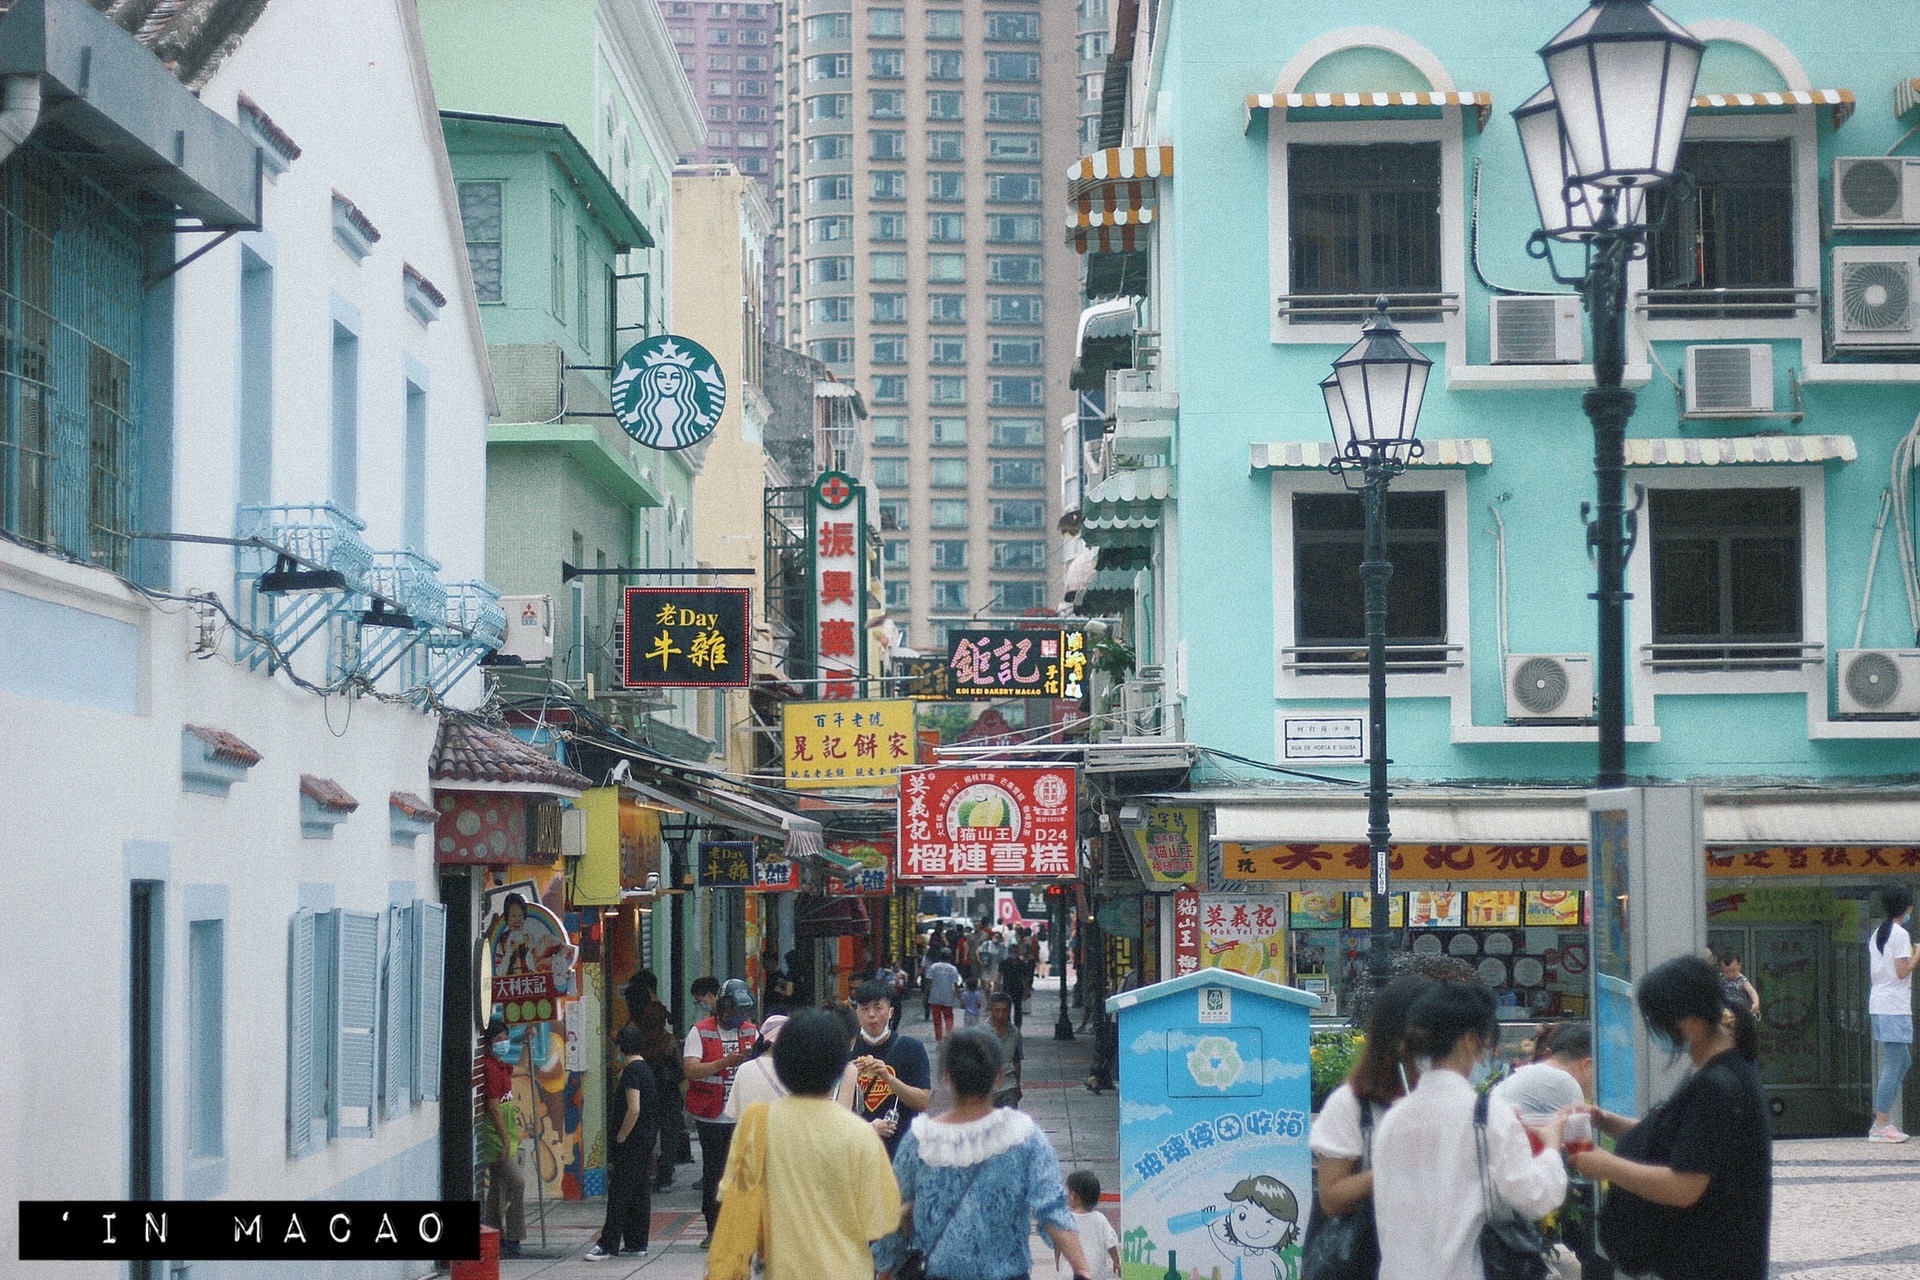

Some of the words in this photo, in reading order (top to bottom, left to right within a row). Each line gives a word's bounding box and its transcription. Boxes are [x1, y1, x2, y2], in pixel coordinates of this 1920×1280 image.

[645, 629, 729, 672] 牛雜
[950, 636, 1041, 686] 鉅記
[1034, 828, 1069, 842] D24
[907, 842, 1070, 873] 榴槤雪糕
[1203, 903, 1278, 929] 莫義記
